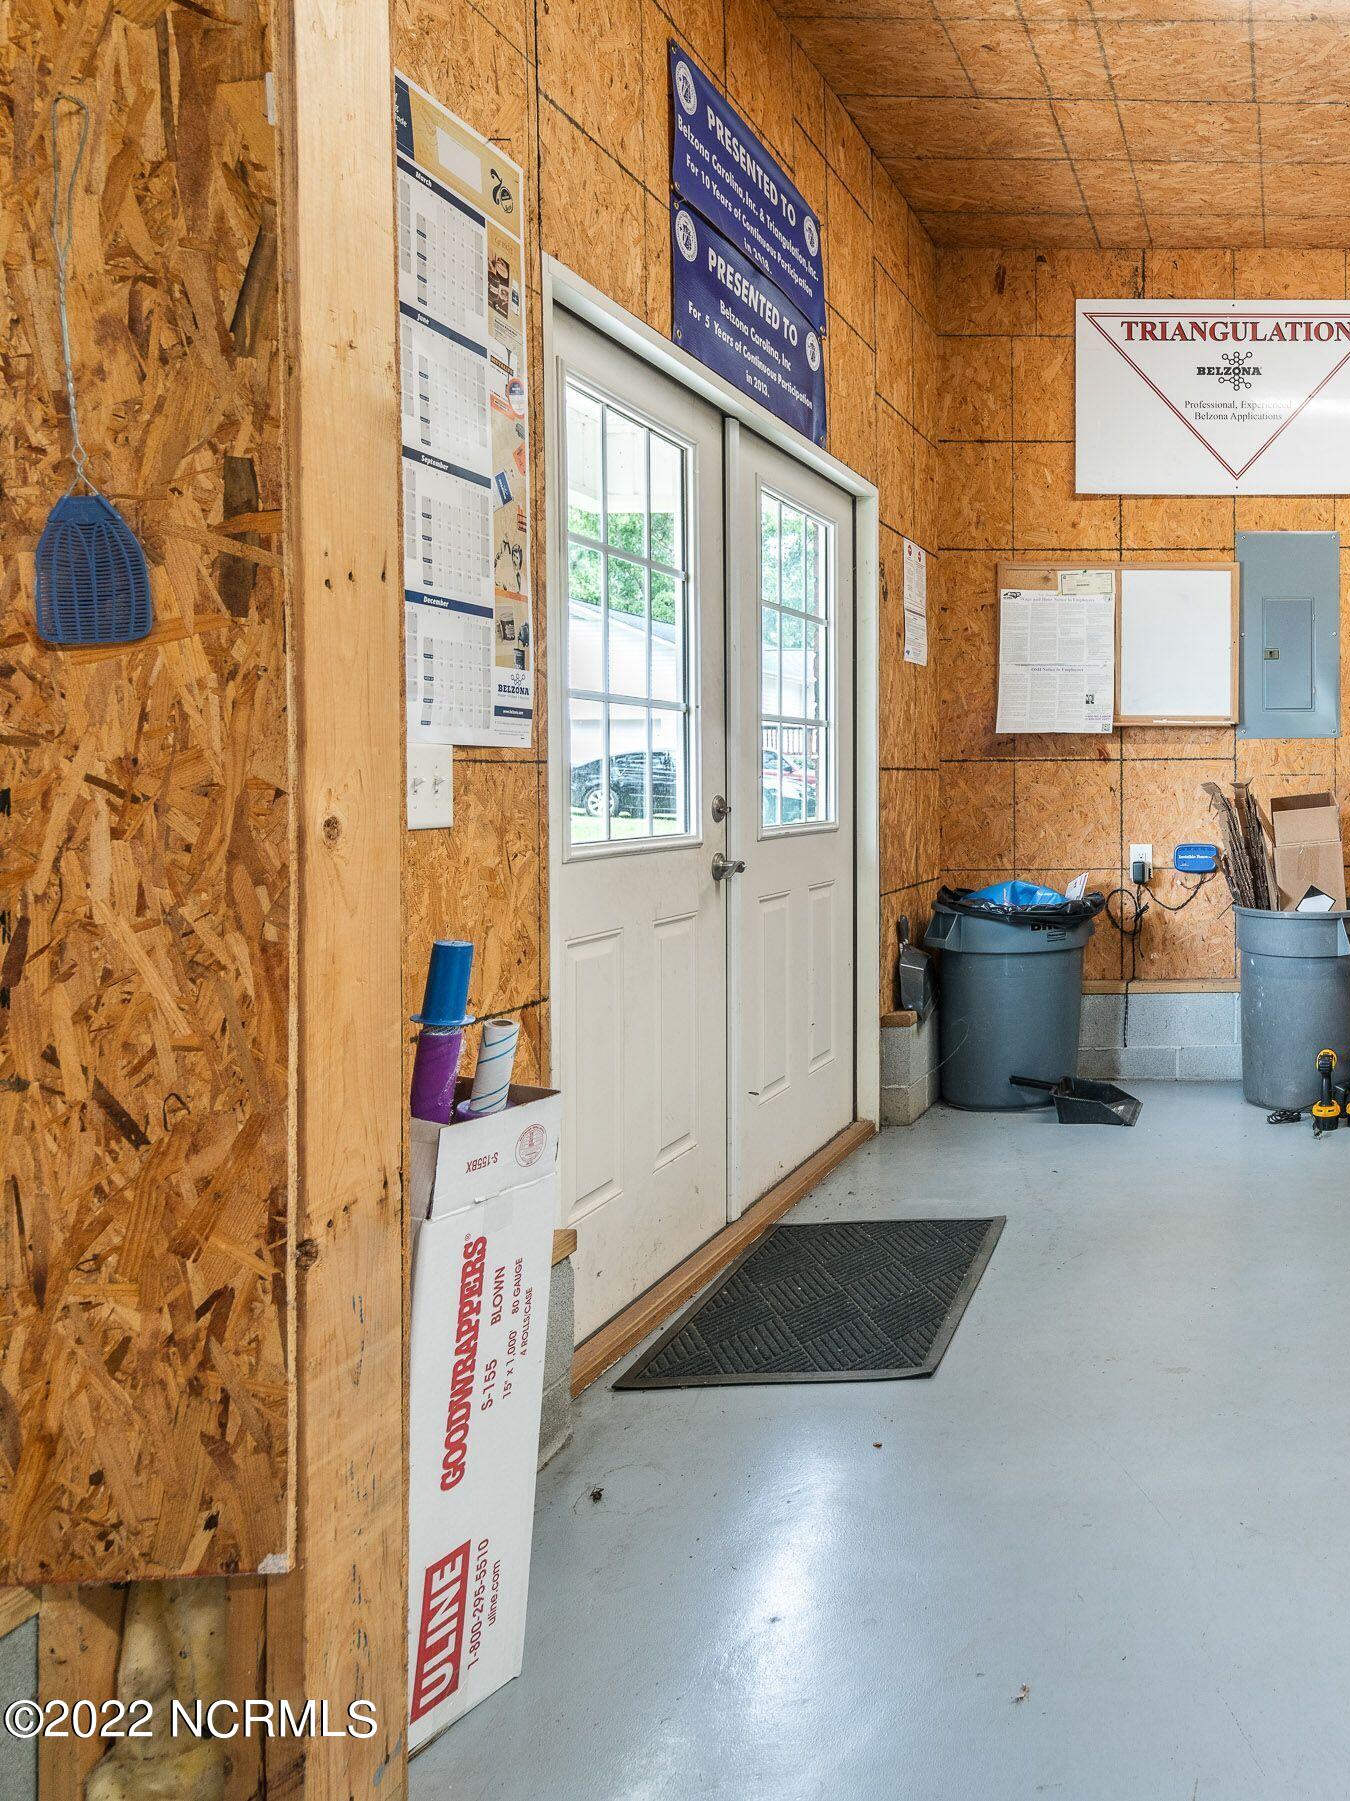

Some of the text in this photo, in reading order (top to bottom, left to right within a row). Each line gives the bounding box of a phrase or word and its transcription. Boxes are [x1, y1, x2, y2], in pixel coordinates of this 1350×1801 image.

[415, 172, 432, 188] March
[677, 114, 710, 162] Belzona
[759, 208, 765, 223] &
[707, 105, 796, 227] PRESENTED TO
[686, 153, 698, 177] For
[701, 170, 711, 190] 10
[712, 181, 733, 213] Years
[734, 206, 742, 222] of
[742, 214, 777, 261] Continuous
[777, 255, 813, 298] Participation
[744, 238, 752, 254] in
[417, 313, 430, 325] June
[708, 247, 798, 347] PRESENTED TO
[688, 300, 701, 322] For
[704, 315, 711, 329] 5
[714, 321, 734, 347] Years
[735, 341, 742, 354] of
[742, 345, 778, 381] Continuous
[778, 373, 813, 410] Participation
[720, 299, 749, 335] Belzona
[750, 327, 781, 364] Carolina,
[782, 353, 792, 371] Inc
[746, 370, 770, 397] in 2013.
[1196, 366, 1263, 376] BELZONA
[1184, 400, 1238, 410] Professional,
[1194, 411, 1283, 422] Belzona Applications
[421, 454, 449, 472] September
[423, 596, 449, 608] December
[497, 684, 530, 696] BELZONA
[466, 1152, 499, 1174] S-155BX
[490, 1266, 506, 1326] BLOWN
[512, 1257, 523, 1315] 80 GAUGE
[521, 1287, 533, 1348] ROLLS/CASE
[481, 1359, 498, 1411] S-155
[467, 1538, 489, 1671] 1-800-295-5510
[488, 1560, 500, 1627] uline.com
[419, 1553, 464, 1709] ULINE
